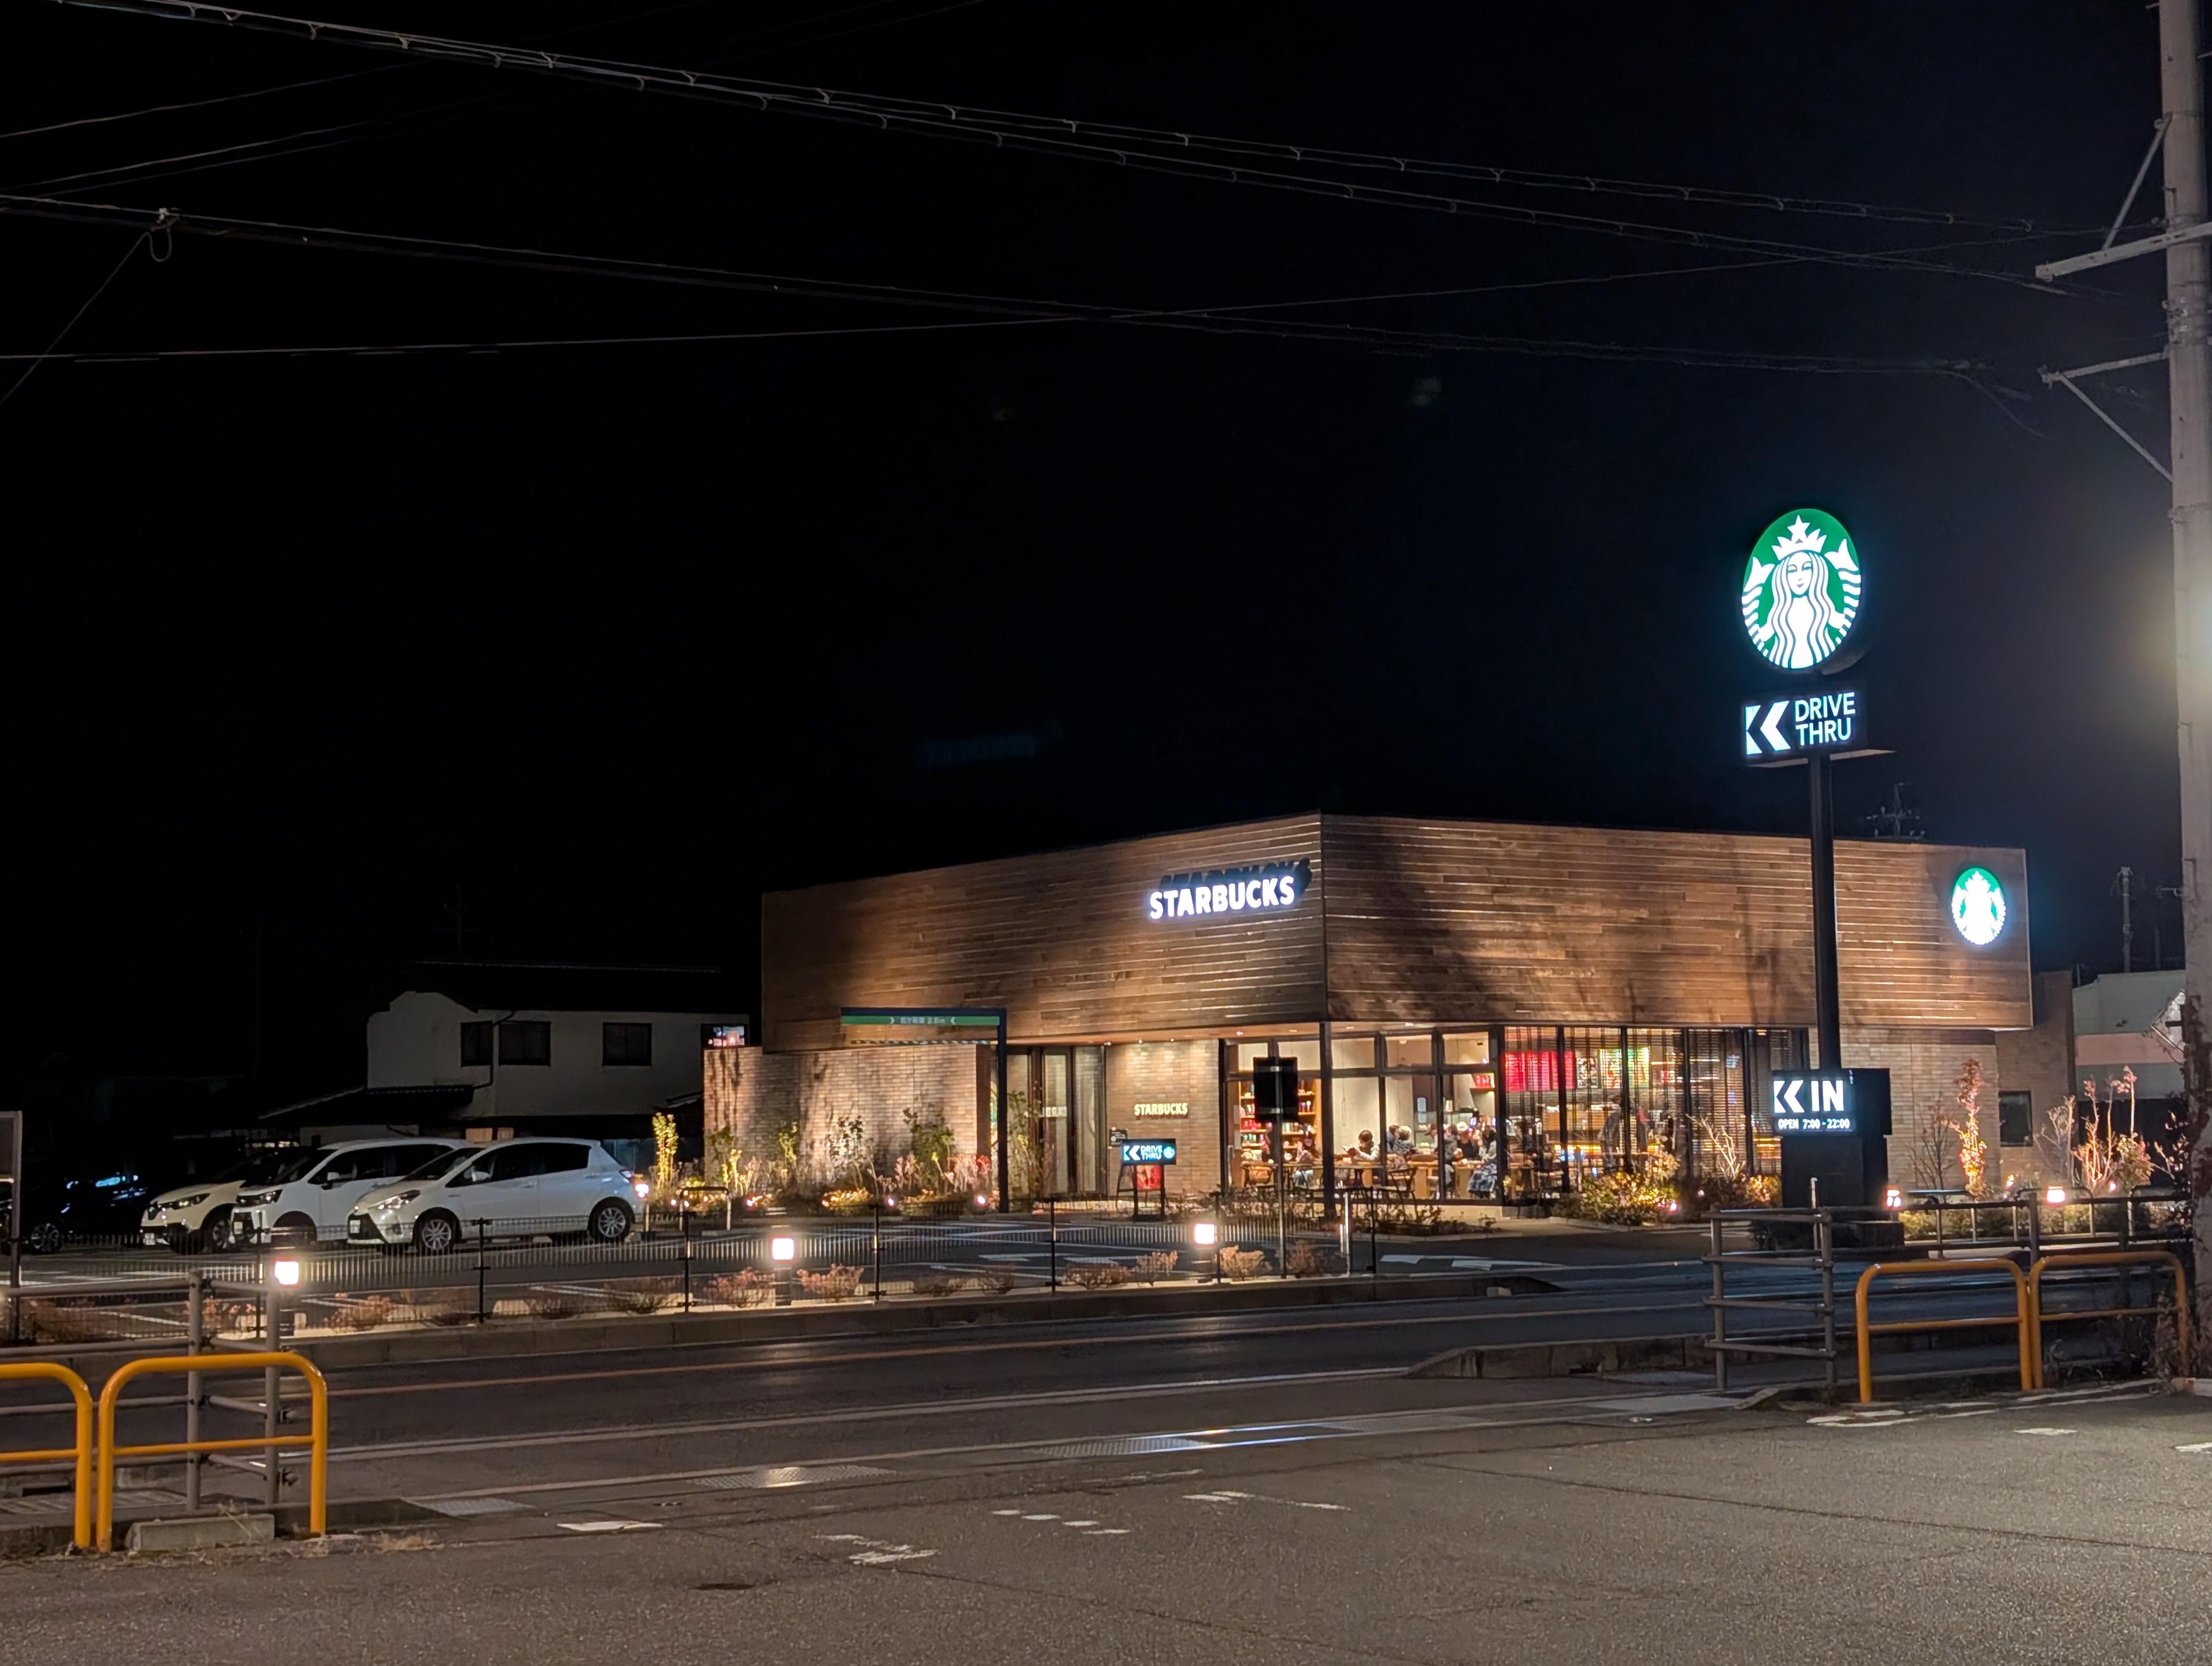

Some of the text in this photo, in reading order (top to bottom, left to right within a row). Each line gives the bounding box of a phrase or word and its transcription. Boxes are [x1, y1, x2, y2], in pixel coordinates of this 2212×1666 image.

[1795, 691, 1856, 722] DRIVE
[1795, 717, 1851, 746] THRU
[1150, 875, 1295, 920] STARBUCKS
[1134, 1103, 1188, 1116] STARBUCKS
[1811, 1080, 1844, 1112] IN
[1778, 1118, 1799, 1129] OPEN
[1802, 1119, 1821, 1129] 7:00
[1827, 1118, 1850, 1129] 22:00
